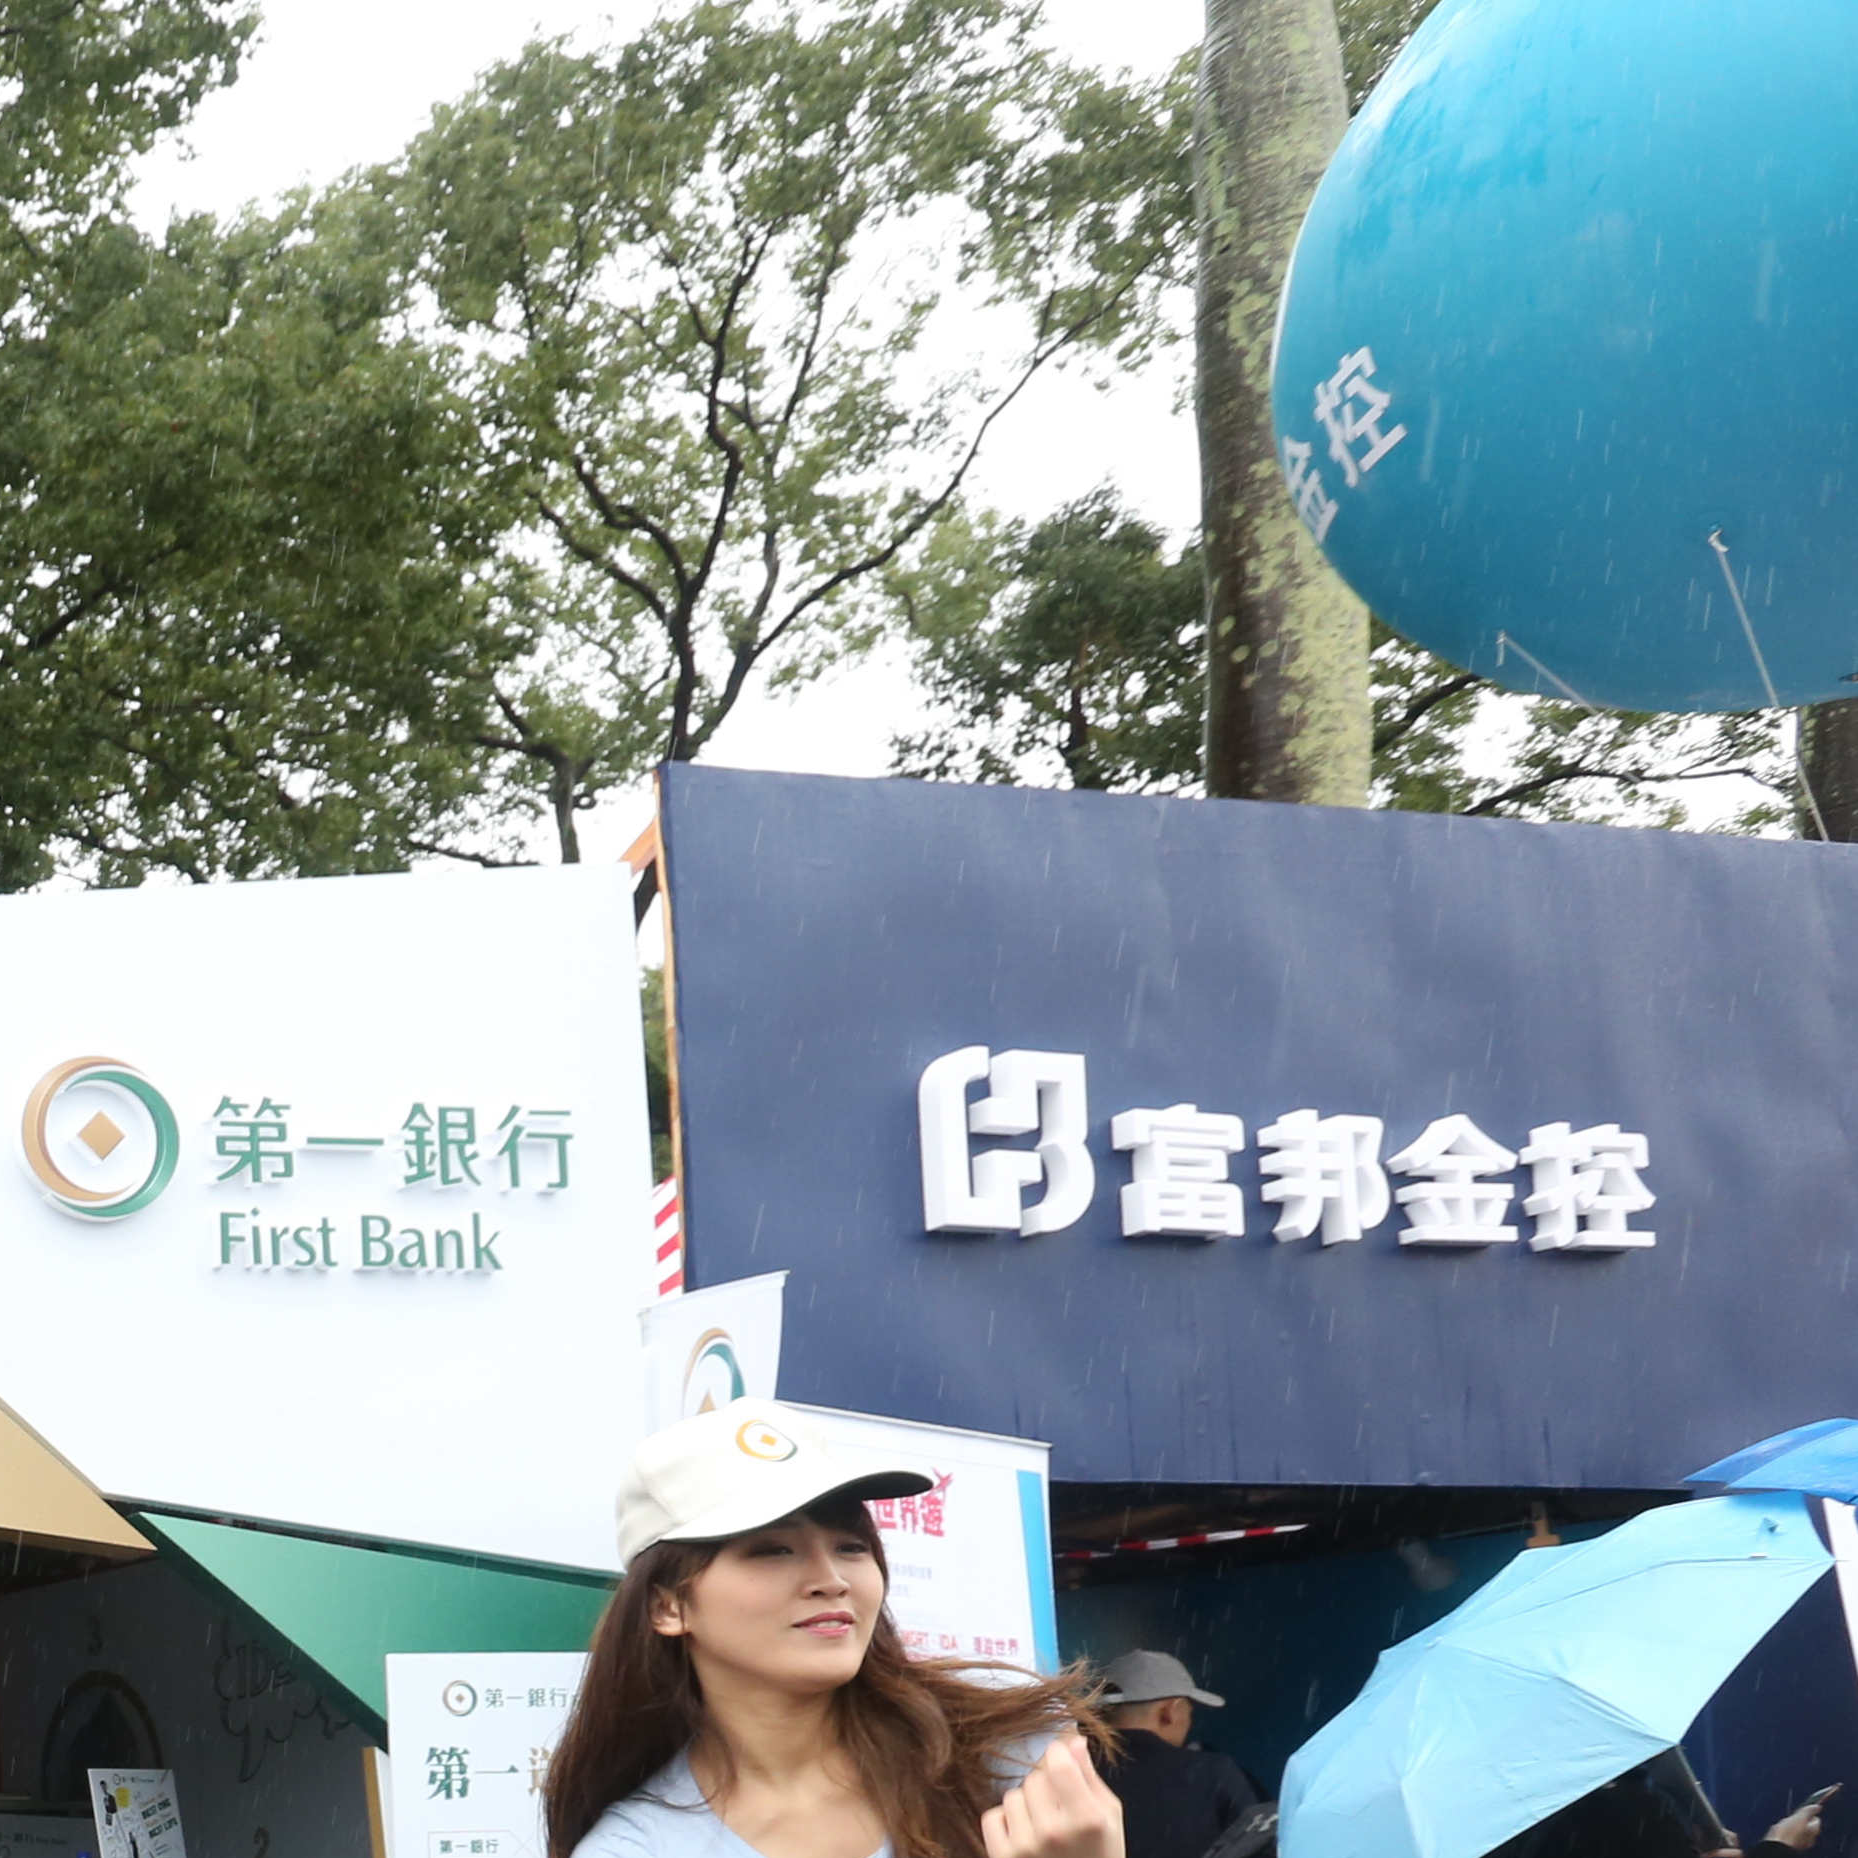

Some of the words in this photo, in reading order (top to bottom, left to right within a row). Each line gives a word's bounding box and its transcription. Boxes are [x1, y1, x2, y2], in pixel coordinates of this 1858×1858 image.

[207, 1094, 574, 1194] 第一銀行
[1110, 1102, 1659, 1253] 富邦金控
[214, 1208, 339, 1268] First
[356, 1210, 504, 1275] Bank
[484, 1686, 569, 1709] 第一銀行
[439, 1838, 499, 1855] 第一銀行
